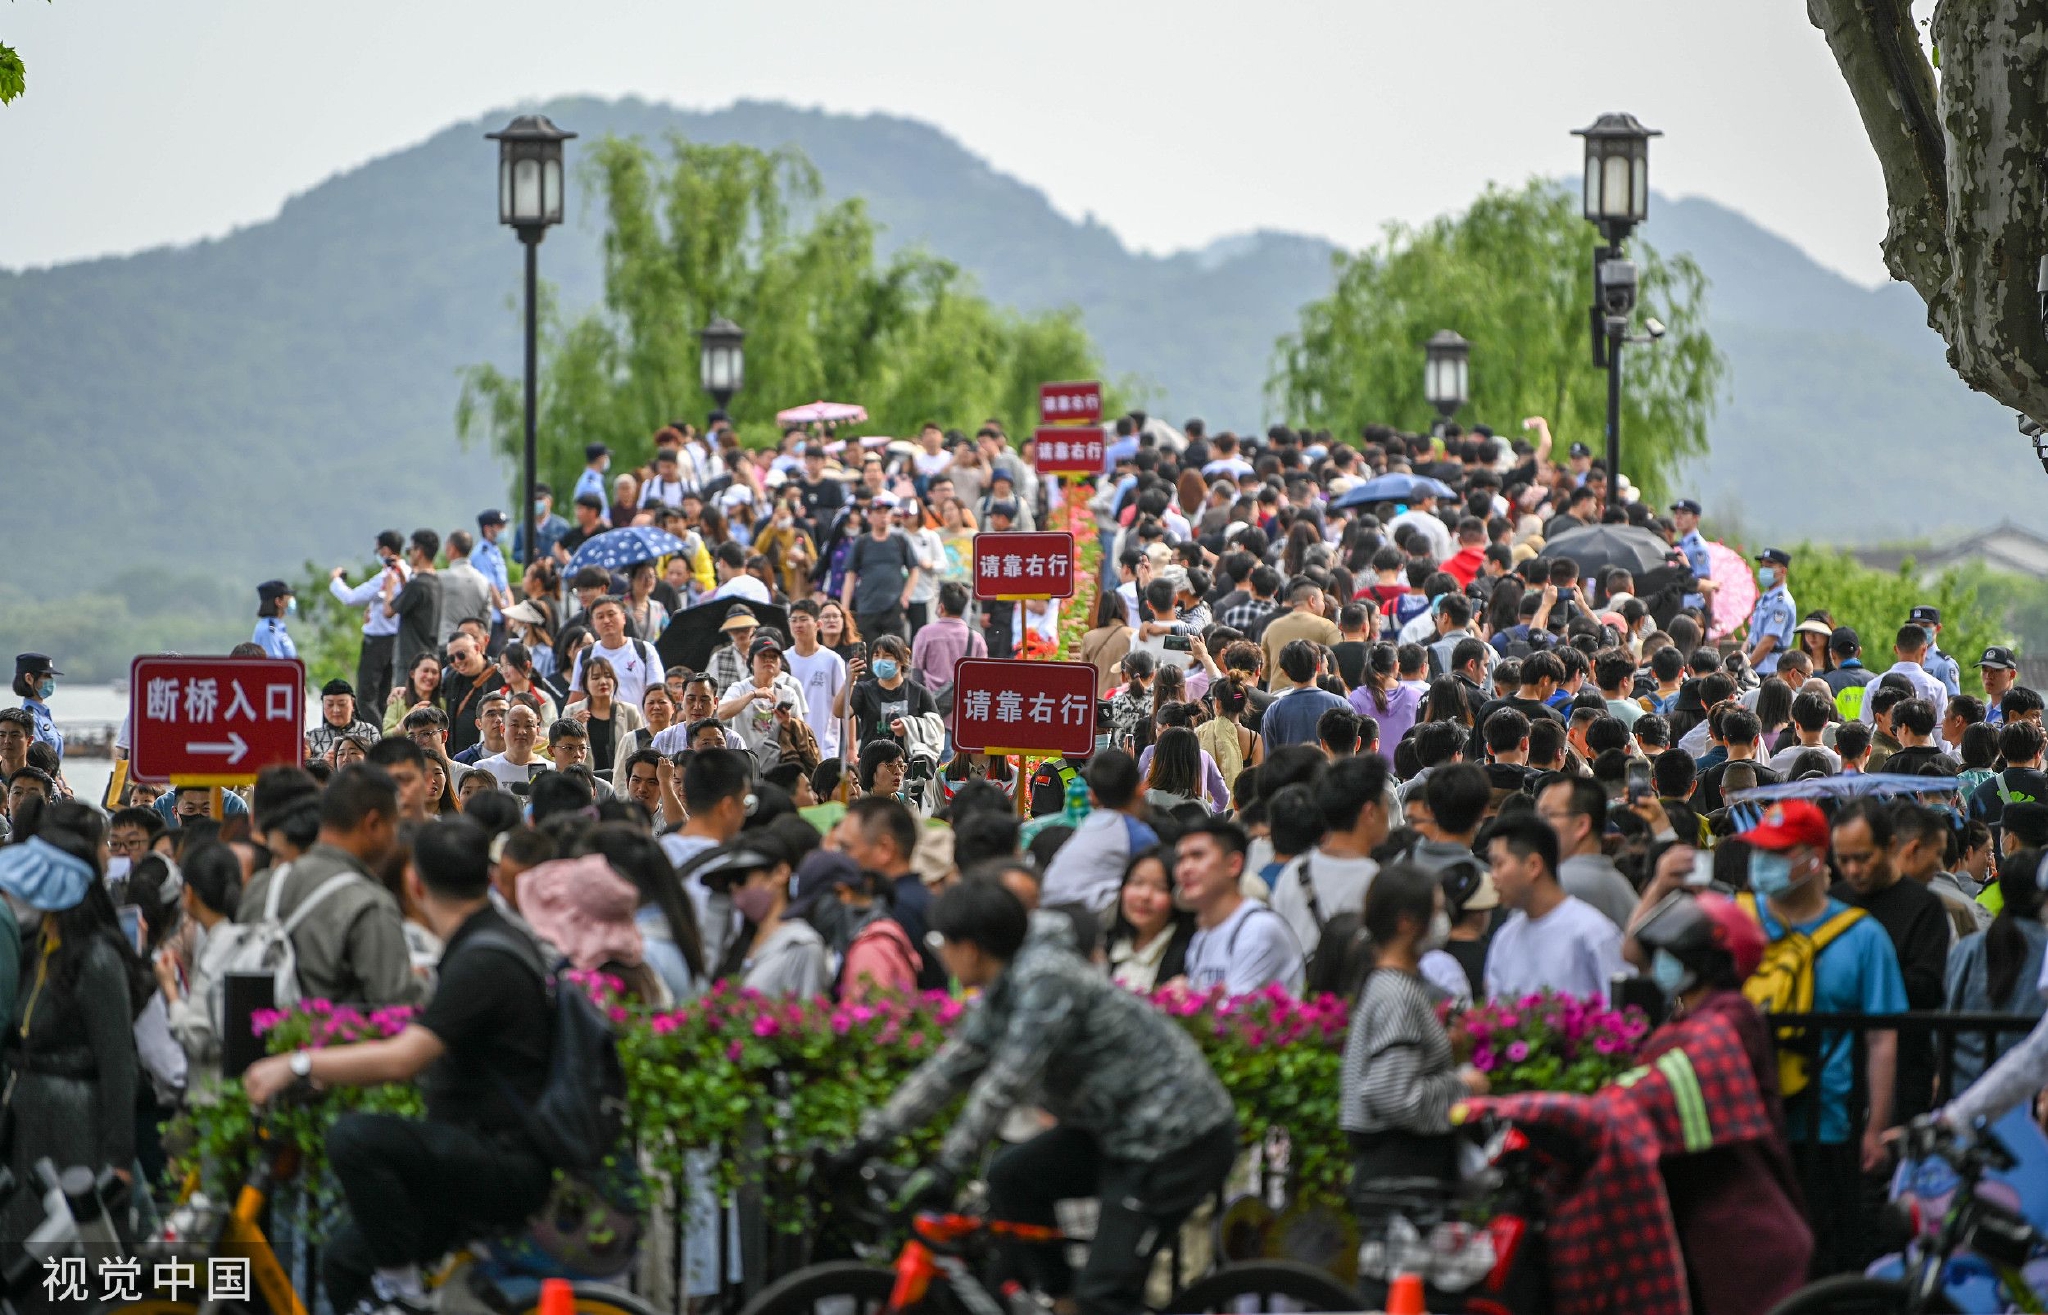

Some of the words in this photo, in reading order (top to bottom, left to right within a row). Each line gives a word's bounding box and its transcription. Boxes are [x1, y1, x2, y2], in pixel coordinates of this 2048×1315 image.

[980, 554, 1068, 578] 请靠右行
[146, 677, 293, 723] 断桥入口
[964, 690, 1088, 725] 请靠右行
